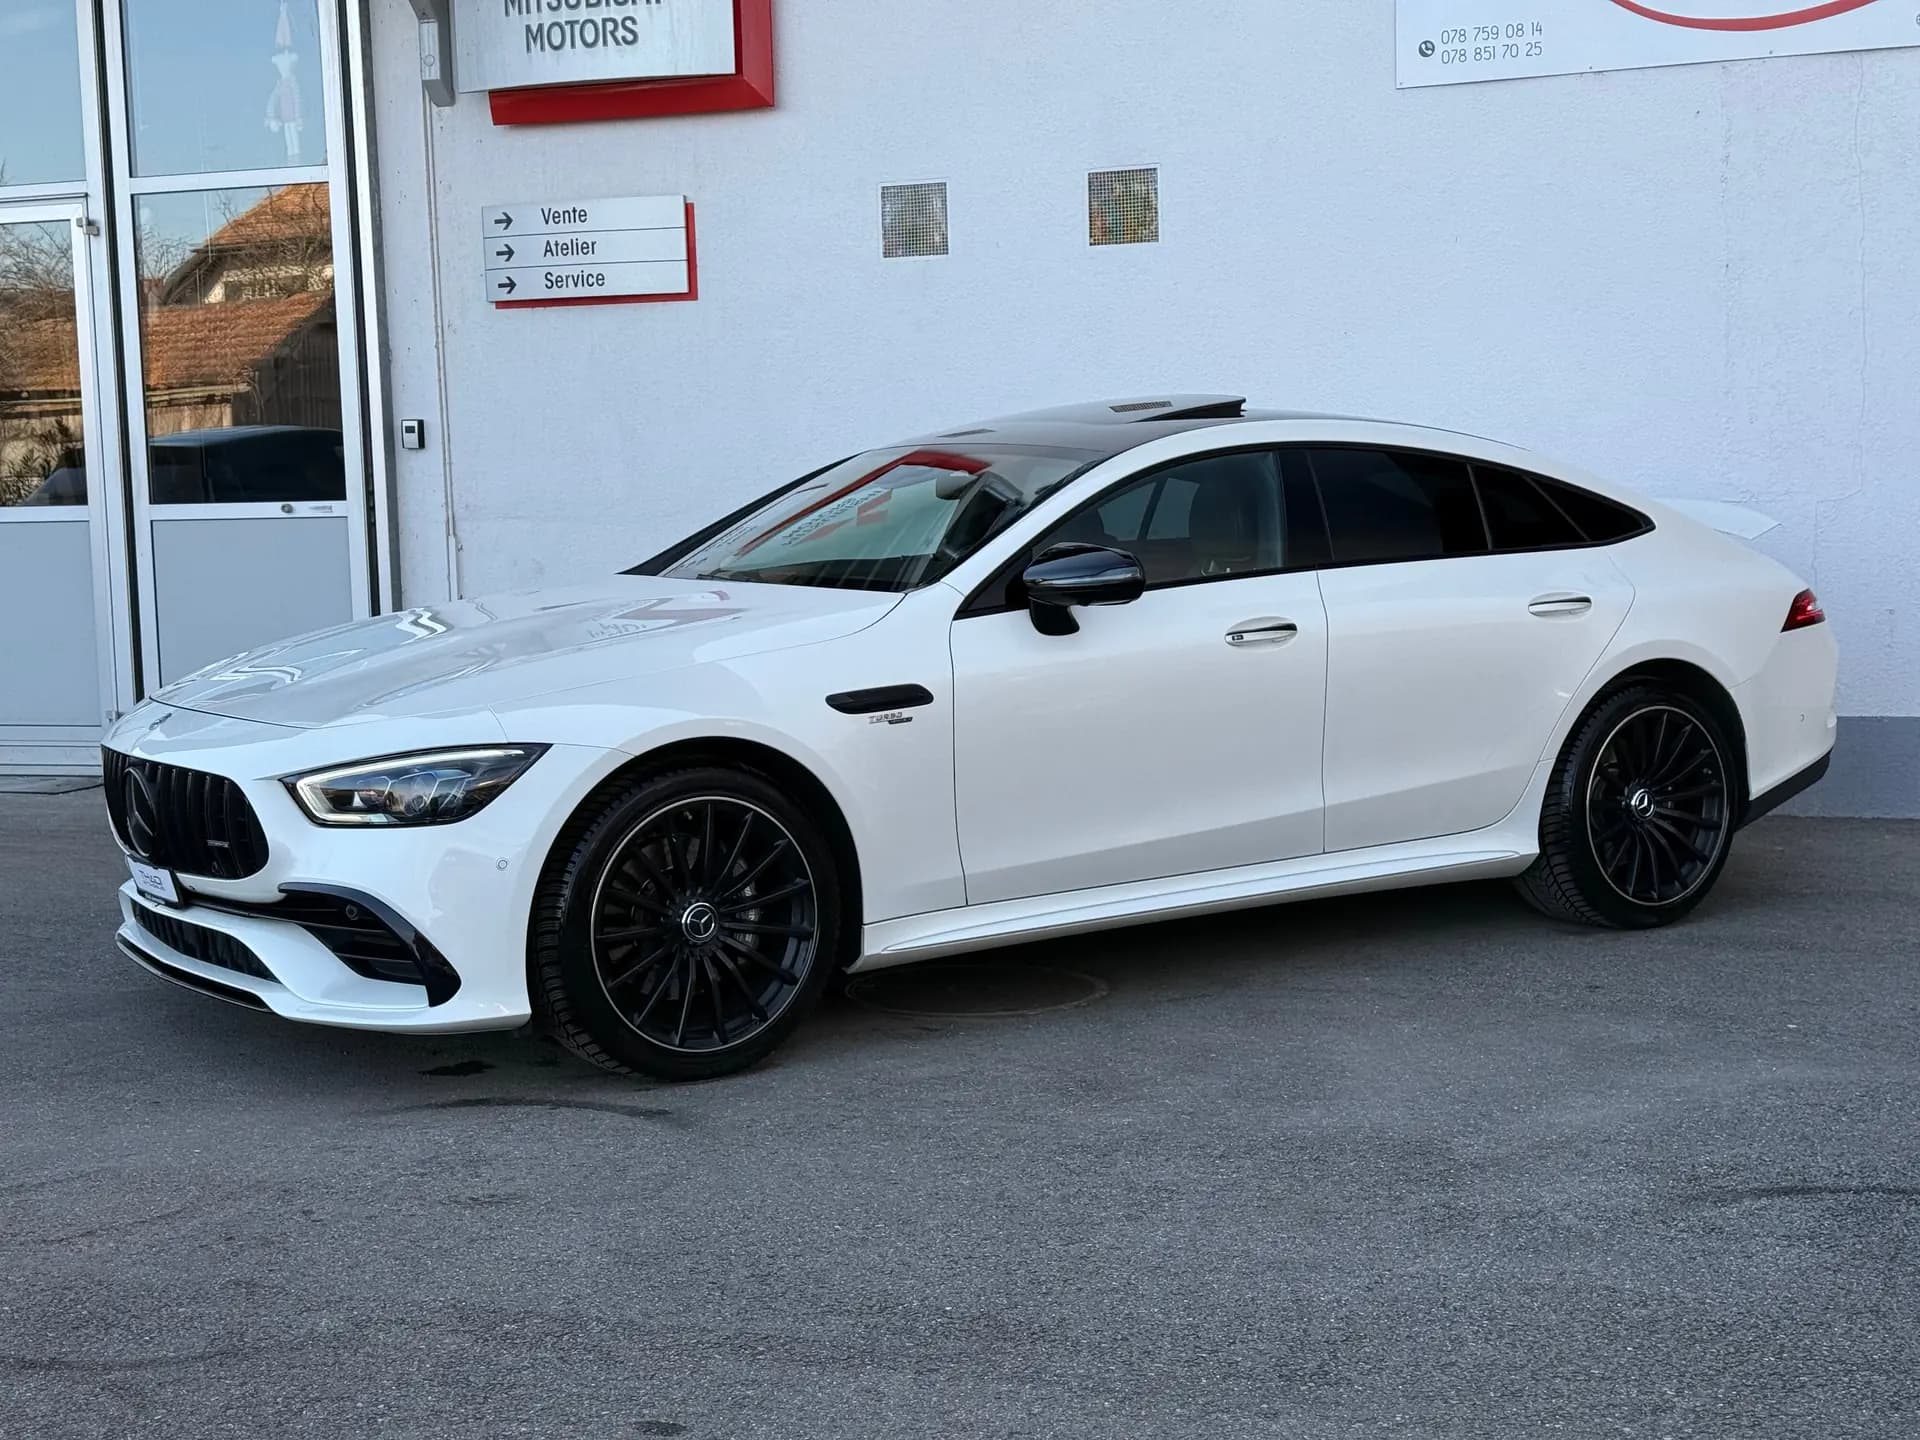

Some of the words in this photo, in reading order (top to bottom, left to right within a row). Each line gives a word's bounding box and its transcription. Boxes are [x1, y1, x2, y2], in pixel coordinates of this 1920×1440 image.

[524, 15, 640, 55] MOTORS
[1440, 28, 1467, 45] 078
[1473, 25, 1500, 42] 759
[1505, 22, 1525, 39] 08
[1531, 20, 1543, 37] 14
[1440, 48, 1467, 65] 078
[1473, 45, 1496, 62] 851
[1501, 43, 1519, 60] 70
[1525, 41, 1543, 57] 25
[540, 206, 588, 226] Vente
[543, 238, 597, 258] Atelier
[544, 269, 606, 290] Service
